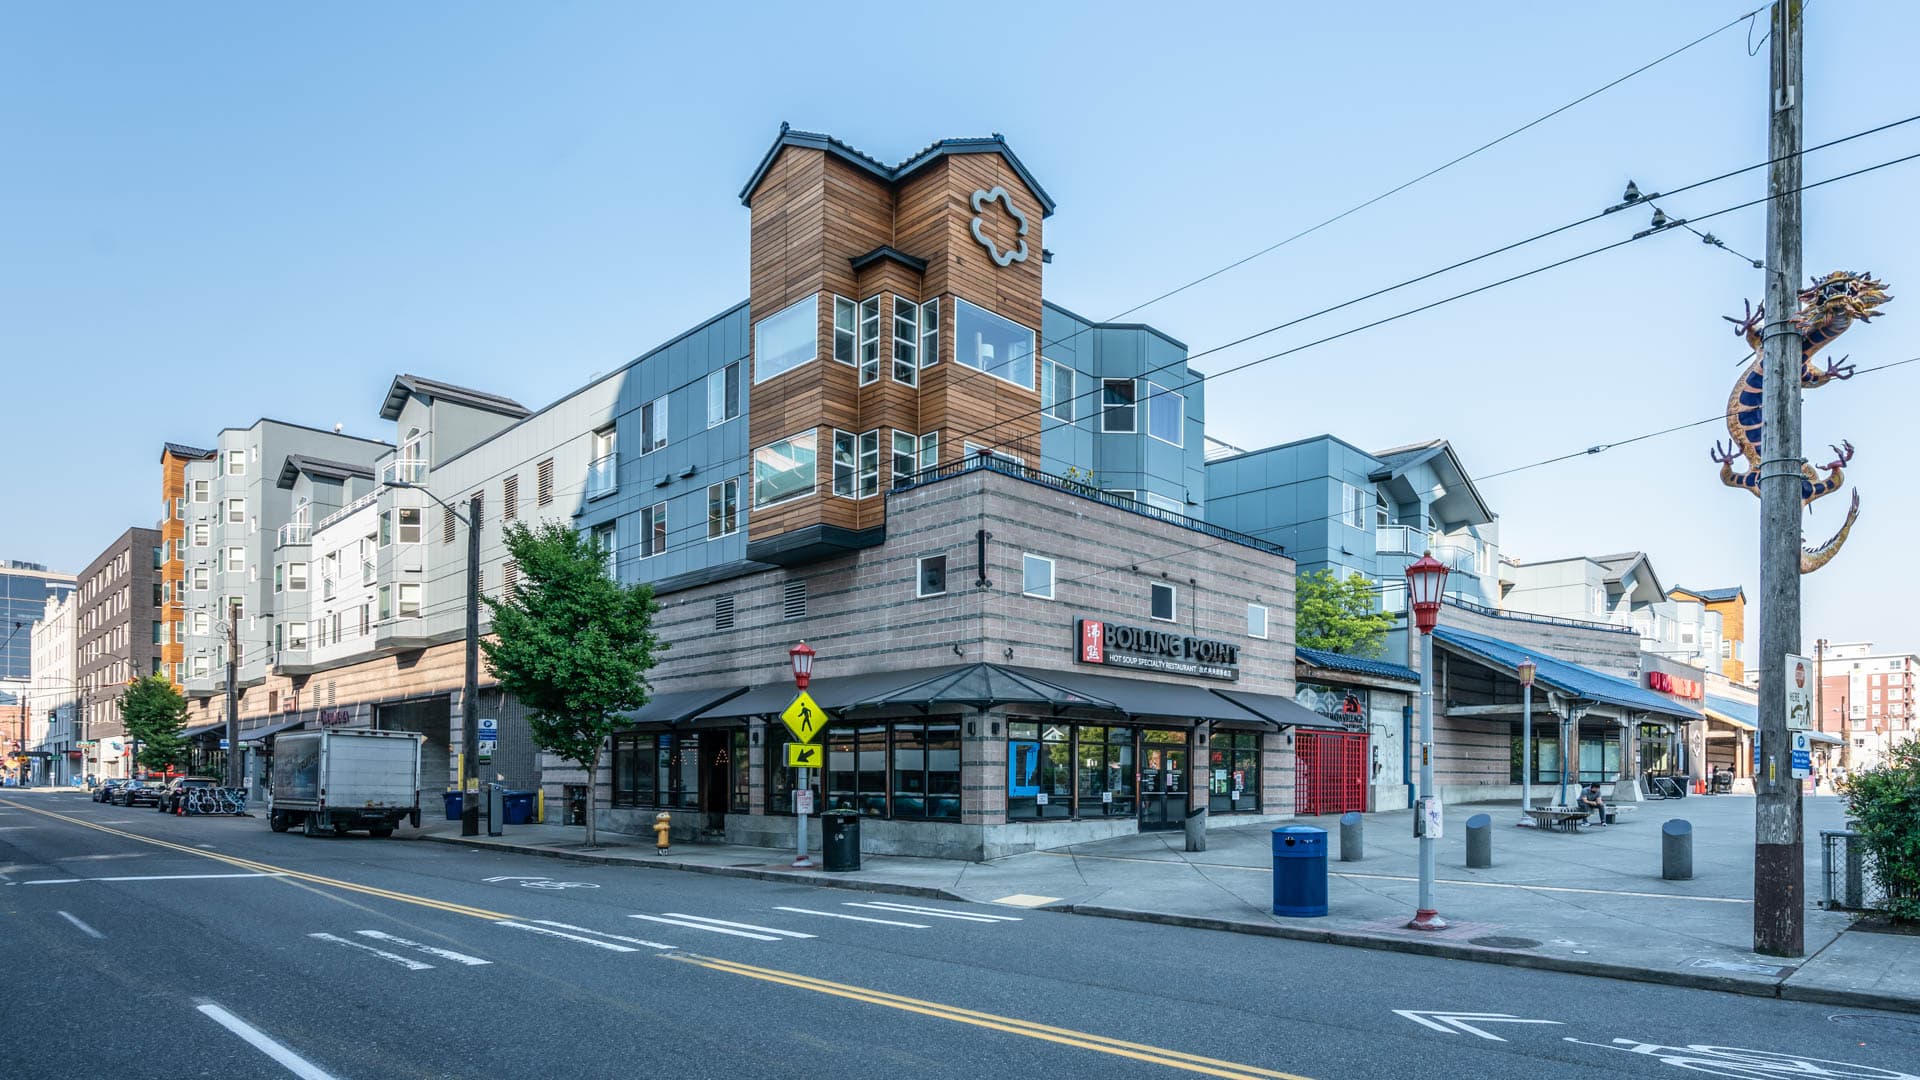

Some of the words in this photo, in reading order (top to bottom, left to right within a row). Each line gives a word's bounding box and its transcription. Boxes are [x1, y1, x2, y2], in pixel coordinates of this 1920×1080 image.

[1104, 623, 1181, 657] BOILING
[1186, 637, 1240, 664] POINT
[1109, 653, 1122, 662] HOT
[1122, 656, 1137, 665] SOUP
[1138, 658, 1165, 669] SPECIALTY
[1165, 662, 1197, 673] RESTAURANT
